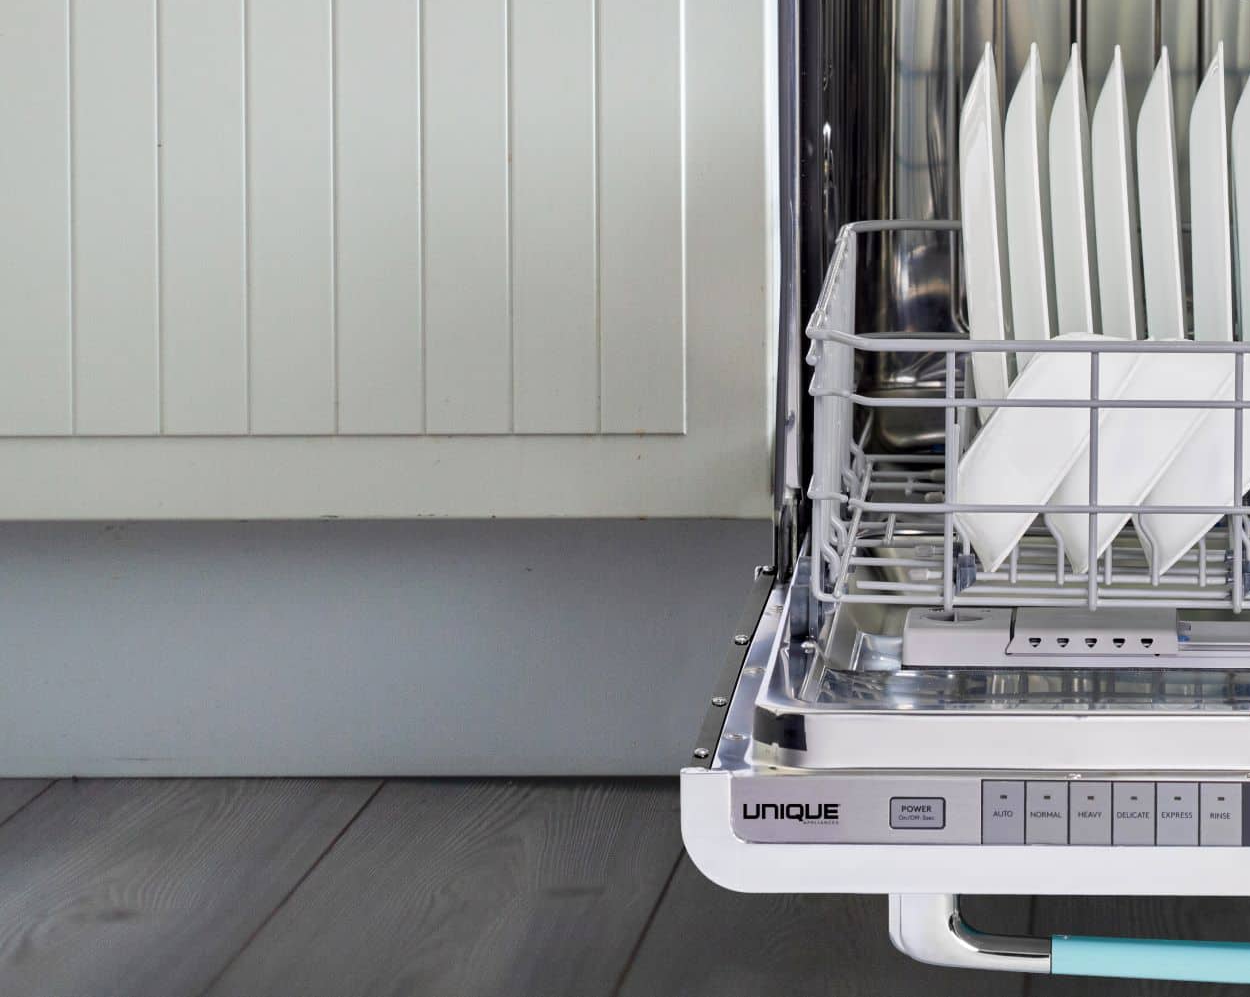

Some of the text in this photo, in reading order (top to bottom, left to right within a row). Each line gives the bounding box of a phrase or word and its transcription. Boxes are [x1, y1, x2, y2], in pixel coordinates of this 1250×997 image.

[743, 803, 839, 821] UNIQUE
[901, 805, 931, 813] POWER
[993, 810, 1013, 818] AUTO
[1030, 811, 1062, 819] NORMAL
[1077, 811, 1102, 819] HEAVY
[1116, 811, 1150, 820] DELICATE
[1209, 812, 1231, 820] RINSE
